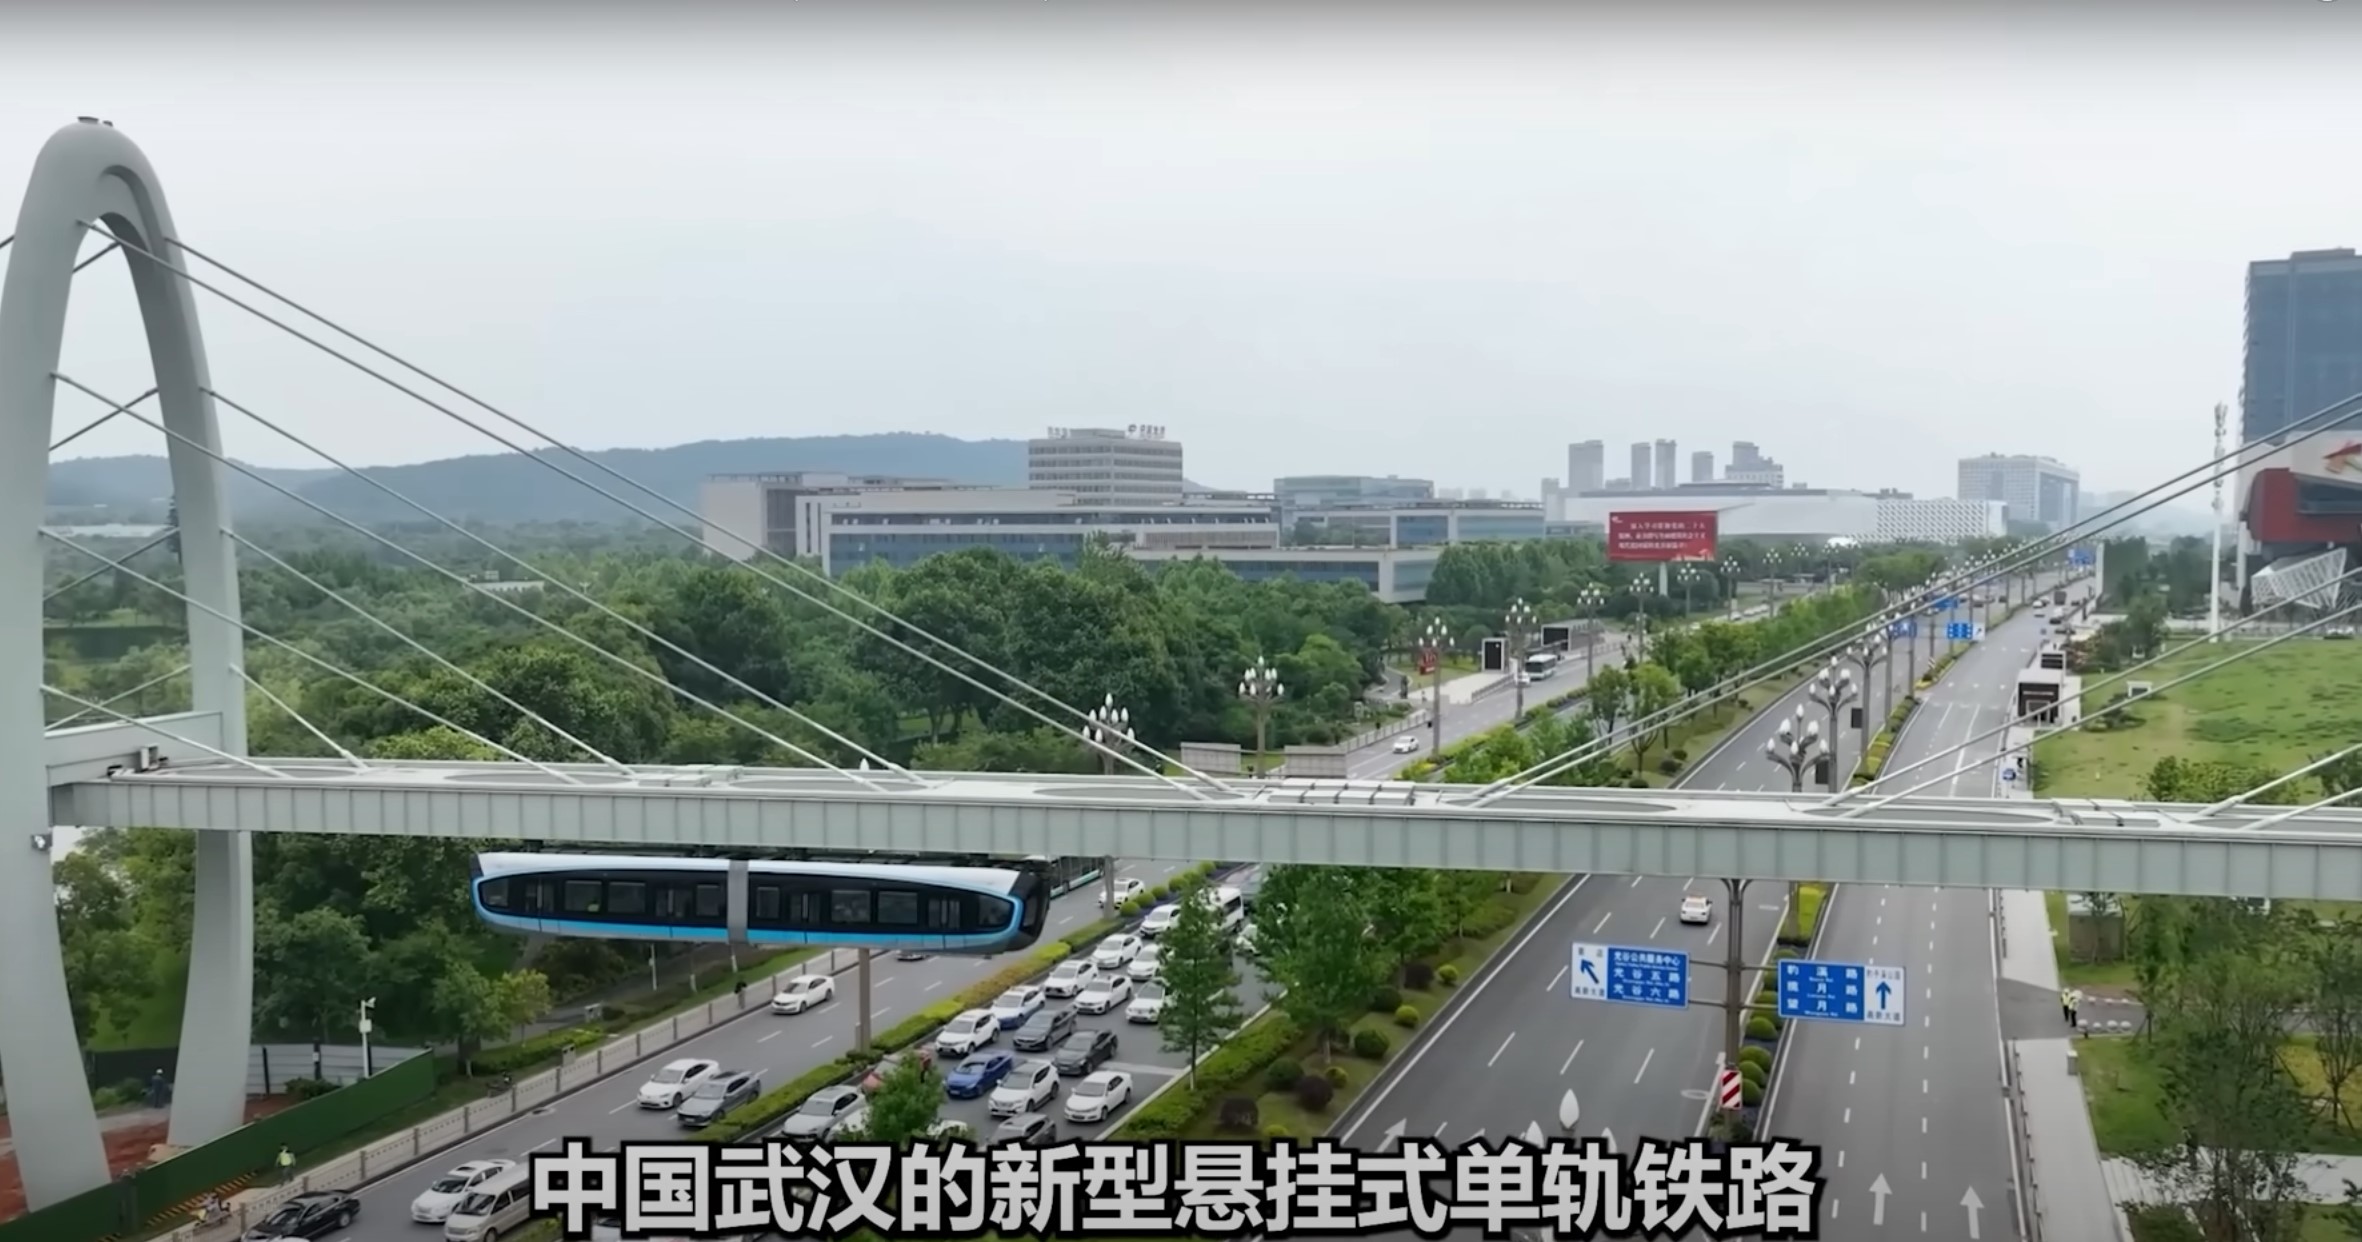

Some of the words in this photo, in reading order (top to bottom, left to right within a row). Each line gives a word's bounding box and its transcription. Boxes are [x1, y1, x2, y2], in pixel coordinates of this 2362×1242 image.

[1614, 951, 1680, 966] 光谷公共服务中心
[1613, 967, 1680, 983] 光谷五路
[1613, 984, 1680, 999] 光谷六路
